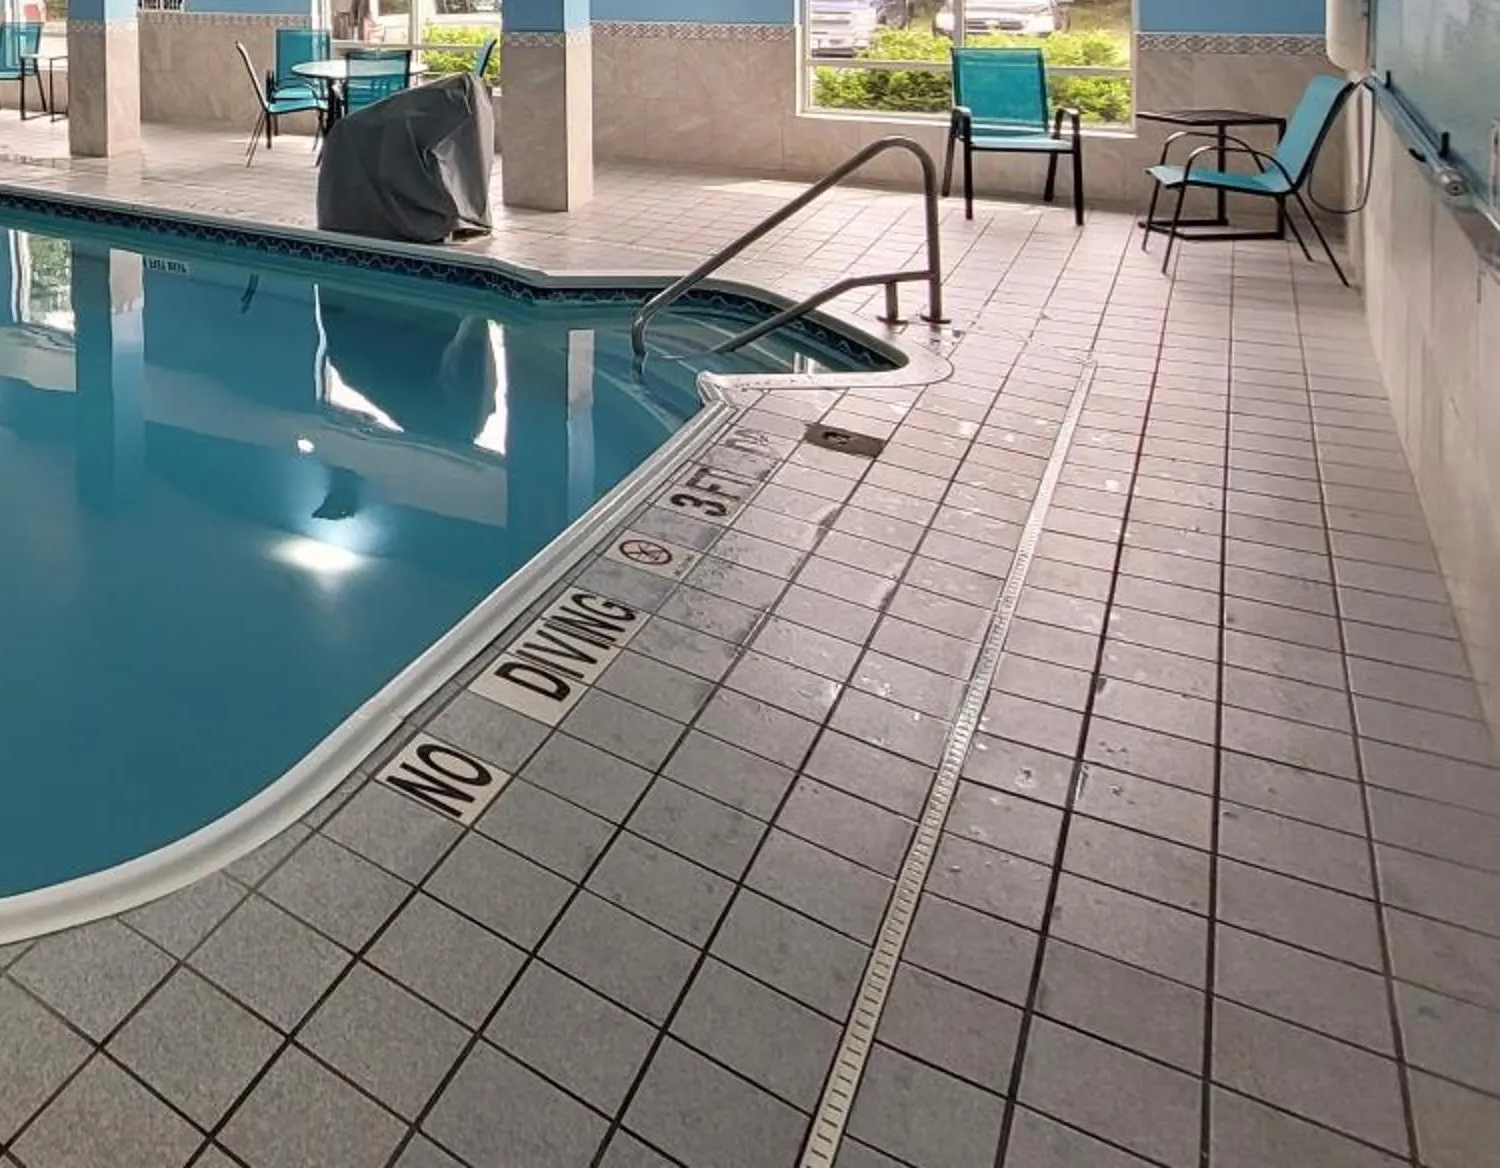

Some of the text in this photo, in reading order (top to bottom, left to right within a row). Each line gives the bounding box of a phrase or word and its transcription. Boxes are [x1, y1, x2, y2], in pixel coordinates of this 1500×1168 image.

[685, 467, 753, 501] FT
[670, 493, 727, 517] 3
[386, 593, 639, 818] NO DIVING
